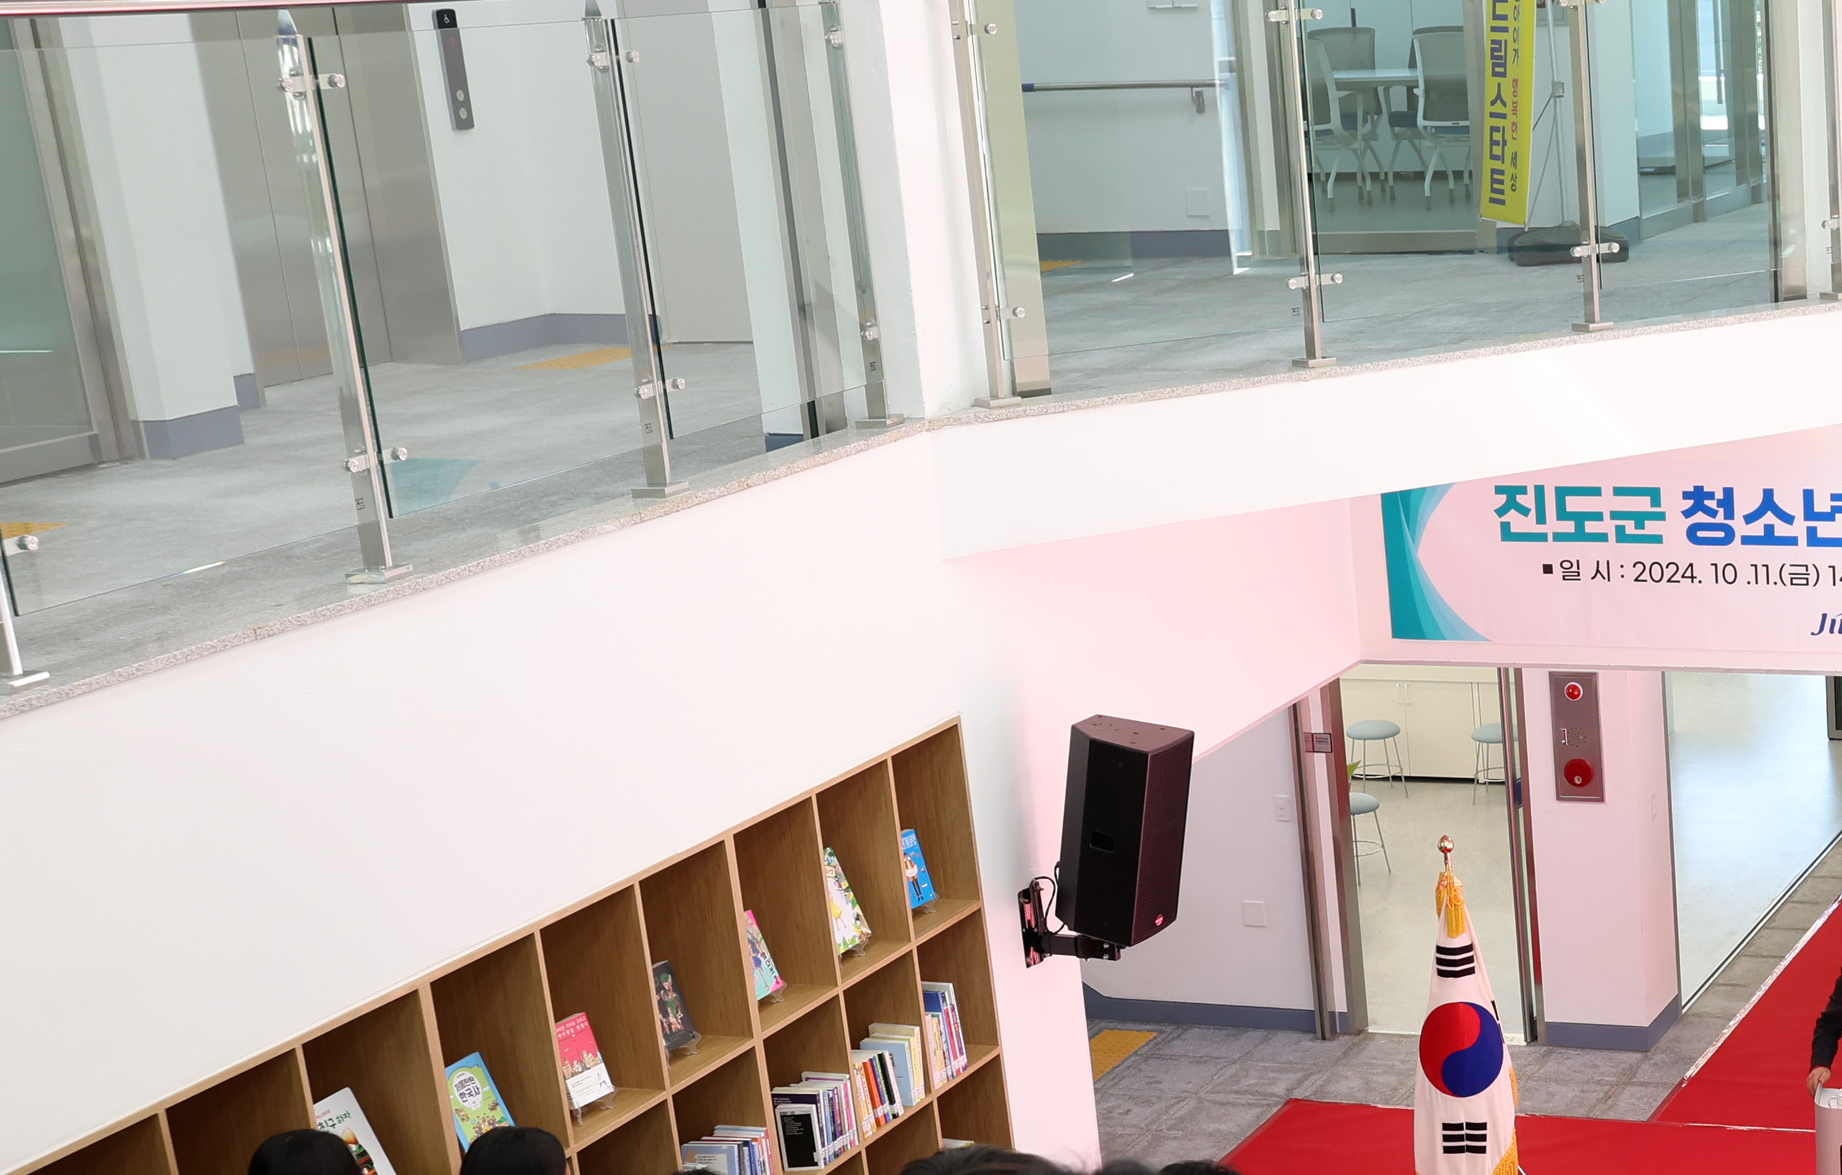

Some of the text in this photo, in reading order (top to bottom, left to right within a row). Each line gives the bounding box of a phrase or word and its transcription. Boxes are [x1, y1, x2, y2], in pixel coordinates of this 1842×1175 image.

[1489, 0, 1510, 206] 드림스타트
[1511, 78, 1519, 141] 행복한
[1510, 151, 1518, 192] 세상
[1493, 484, 1666, 544] 진도군
[1559, 559, 1581, 581] 일
[1590, 560, 1611, 582] 시
[1632, 561, 1703, 584] 2024.
